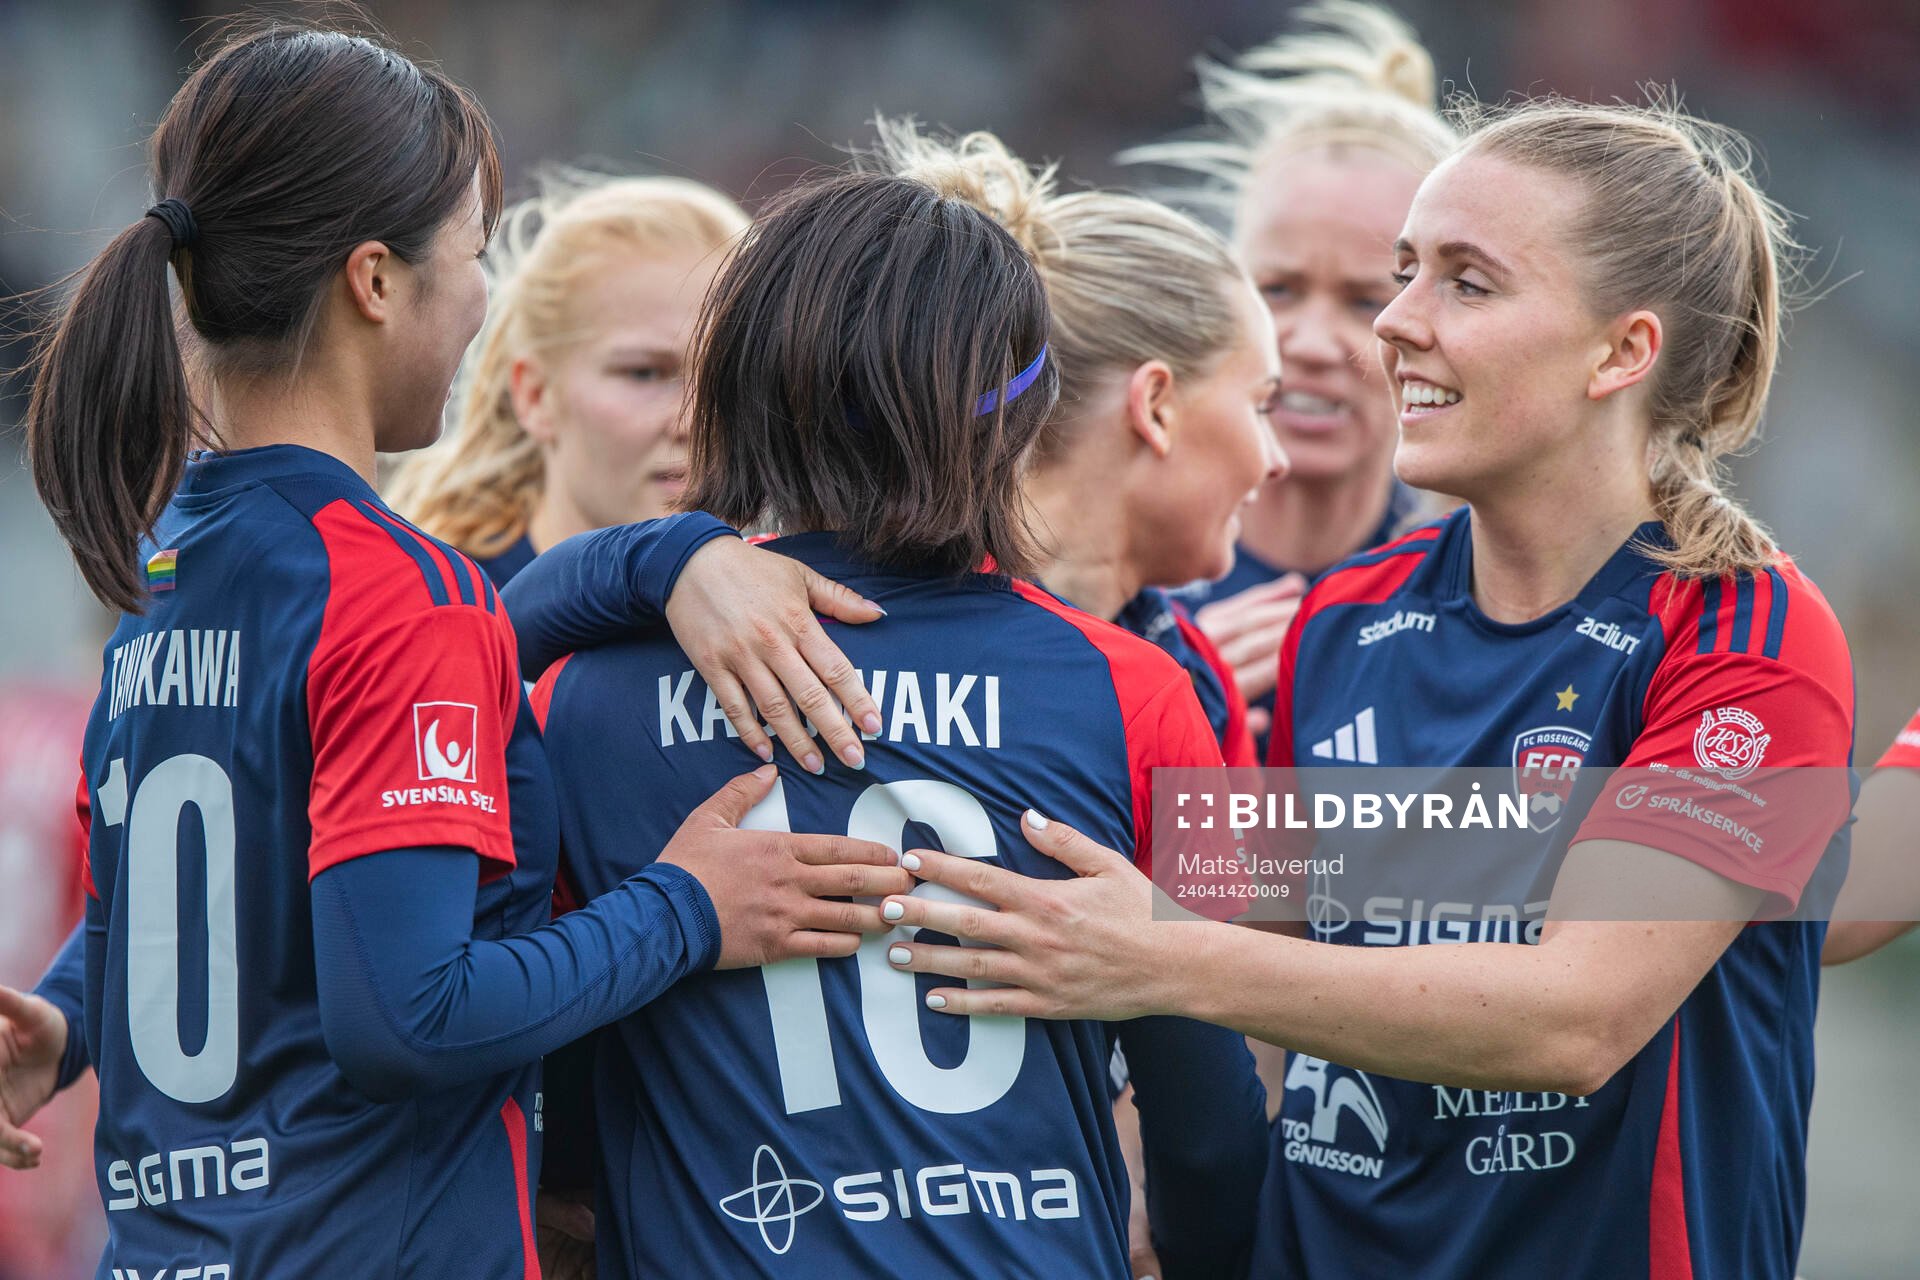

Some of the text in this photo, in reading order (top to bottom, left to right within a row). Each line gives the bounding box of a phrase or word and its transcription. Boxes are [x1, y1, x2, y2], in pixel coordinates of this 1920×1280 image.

[108, 629, 241, 722] TANIKAWA
[1523, 736, 1535, 747] FC
[1704, 727, 1753, 761] HSB
[1521, 751, 1582, 782] FCR
[1676, 768, 1694, 781] där
[381, 785, 468, 808] SVENSKA
[1648, 796, 1764, 854] SPRÅKSERVICE
[1284, 1140, 1385, 1179] GNUSSON
[1465, 1124, 1576, 1175] GÅRD
